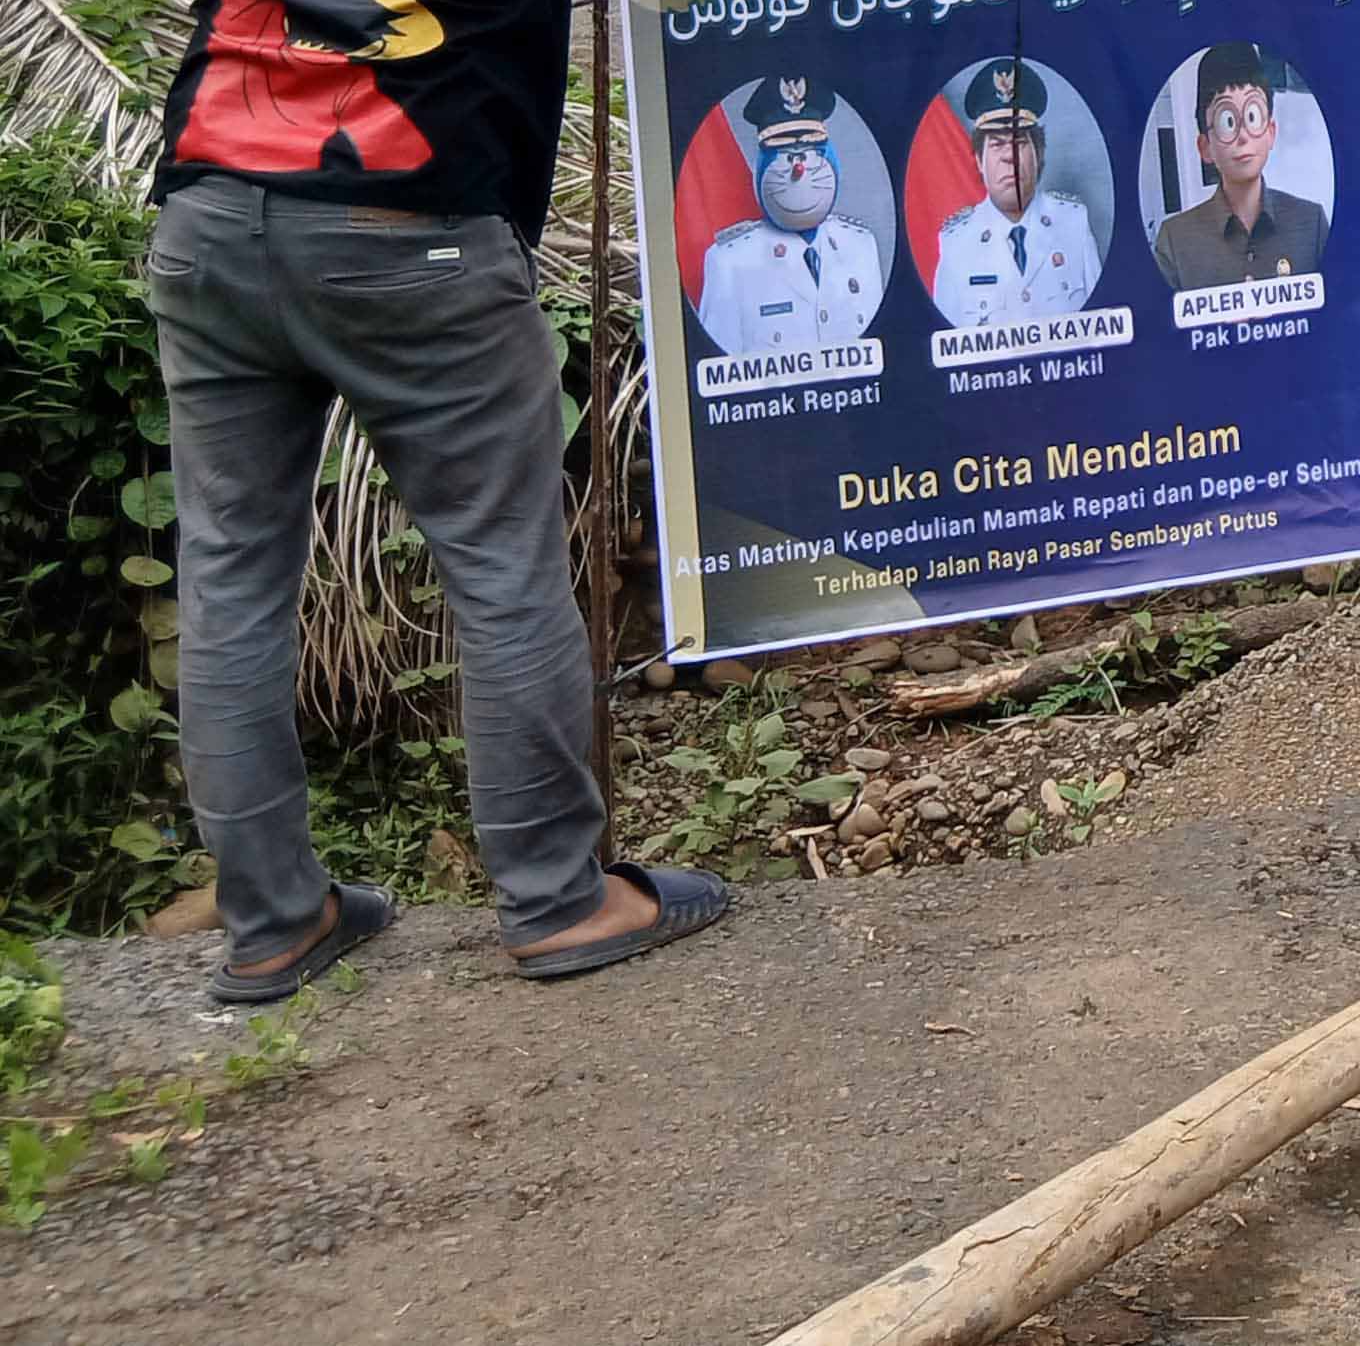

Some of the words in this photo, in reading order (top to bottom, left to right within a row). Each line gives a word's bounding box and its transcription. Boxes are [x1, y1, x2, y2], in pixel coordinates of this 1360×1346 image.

[1181, 290, 1245, 318] APLER
[1251, 280, 1316, 307] YUNIS
[938, 324, 1042, 358] MAMANG
[1048, 314, 1125, 342] KAYAN
[1190, 326, 1231, 351] Pak
[1236, 316, 1310, 344] Dewan
[705, 351, 813, 386] MAMANG
[820, 345, 874, 370] TIDI
[949, 364, 1033, 395] Mamak
[1039, 352, 1105, 383] Wakil
[708, 392, 796, 426] Mamak
[803, 381, 882, 414] Repati
[837, 465, 940, 511] Duka
[952, 454, 1034, 495] Cita
[1046, 423, 1241, 481] Mendalam
[674, 551, 732, 579] Atas
[738, 535, 836, 570] Matinya
[843, 516, 976, 554] Kepedulian
[983, 501, 1065, 532] Mamak
[1072, 487, 1146, 519] Repati
[1152, 483, 1193, 507] dan
[1200, 467, 1289, 501] Depe-er
[813, 562, 919, 597] Terhadap
[925, 555, 981, 582] Jalan
[987, 547, 1039, 574] Raya
[1045, 536, 1103, 562] Pasar
[1110, 517, 1214, 552] Sembayat
[1219, 508, 1279, 536] Putus
